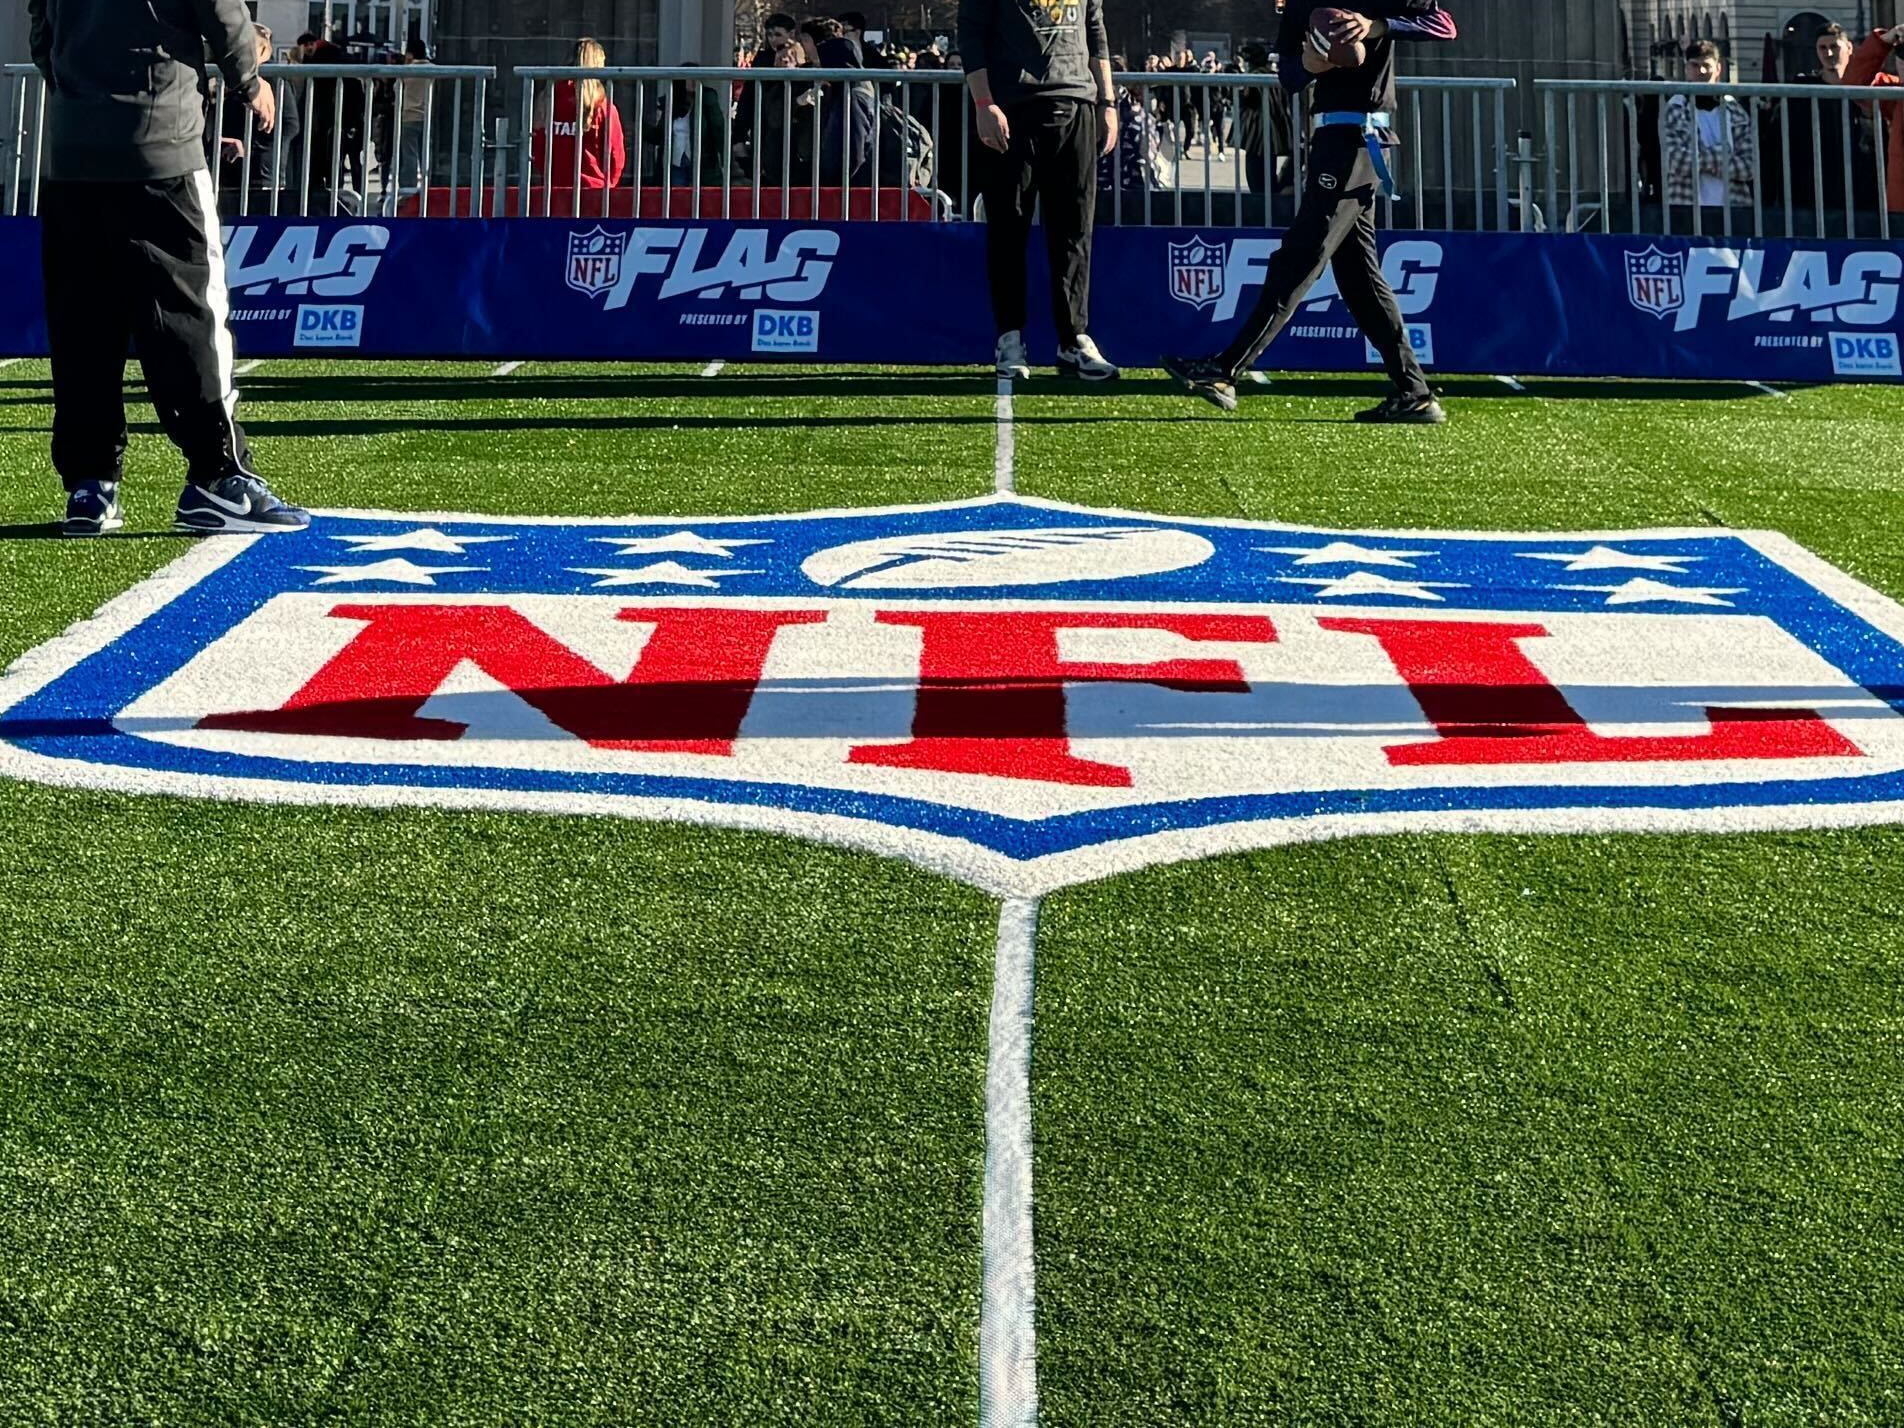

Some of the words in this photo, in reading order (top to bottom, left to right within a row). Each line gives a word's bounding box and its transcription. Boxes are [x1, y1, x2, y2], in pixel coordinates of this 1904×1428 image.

[221, 225, 390, 296] LAG
[573, 257, 615, 286] NFL
[603, 227, 840, 311] FLAG
[1177, 268, 1220, 295] NFL
[1212, 239, 1443, 322] FG
[1635, 277, 1679, 305] NFL
[1674, 247, 1903, 332] FLAG
[230, 310, 275, 320] RESENTED
[301, 310, 357, 331] DKB
[757, 314, 814, 337] DKB
[1836, 337, 1893, 359] DKB
[194, 602, 1870, 788] NFL
